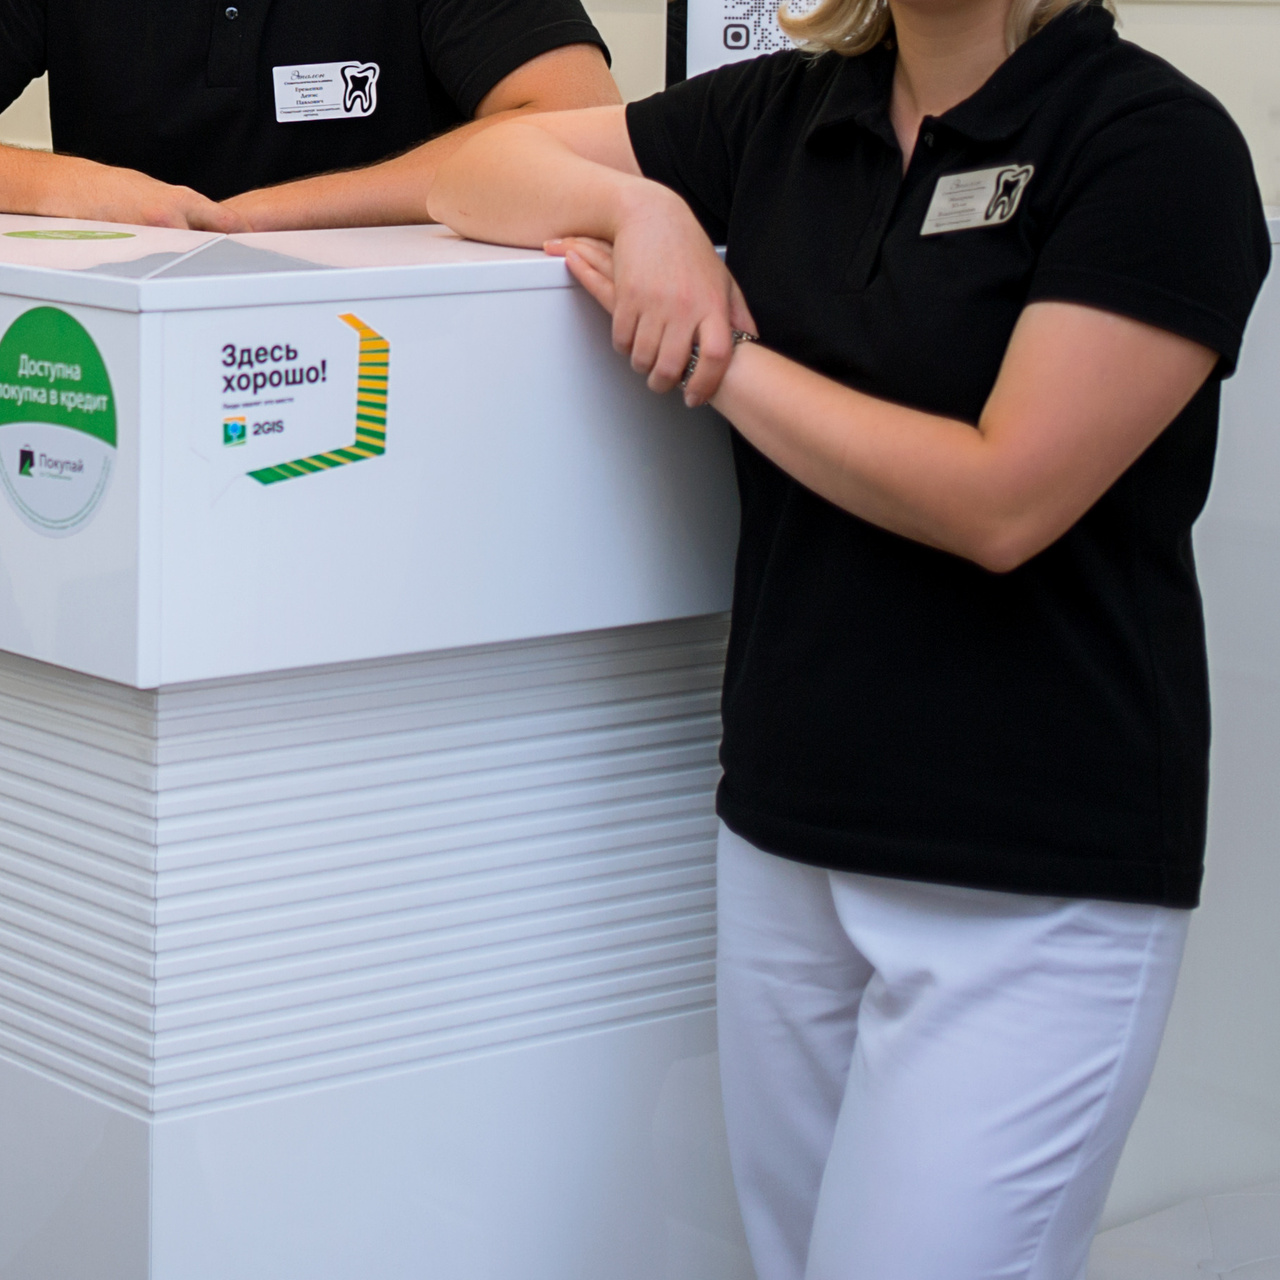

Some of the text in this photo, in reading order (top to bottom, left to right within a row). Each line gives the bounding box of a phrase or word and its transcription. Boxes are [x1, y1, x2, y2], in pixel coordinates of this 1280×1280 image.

[18, 354, 81, 382] Доступна
[222, 344, 298, 370] Здесь
[222, 359, 327, 396] хорошо!
[49, 389, 58, 405] в
[60, 391, 107, 413] кредит
[252, 420, 284, 436] 2GIS
[39, 453, 84, 475] Покупай
